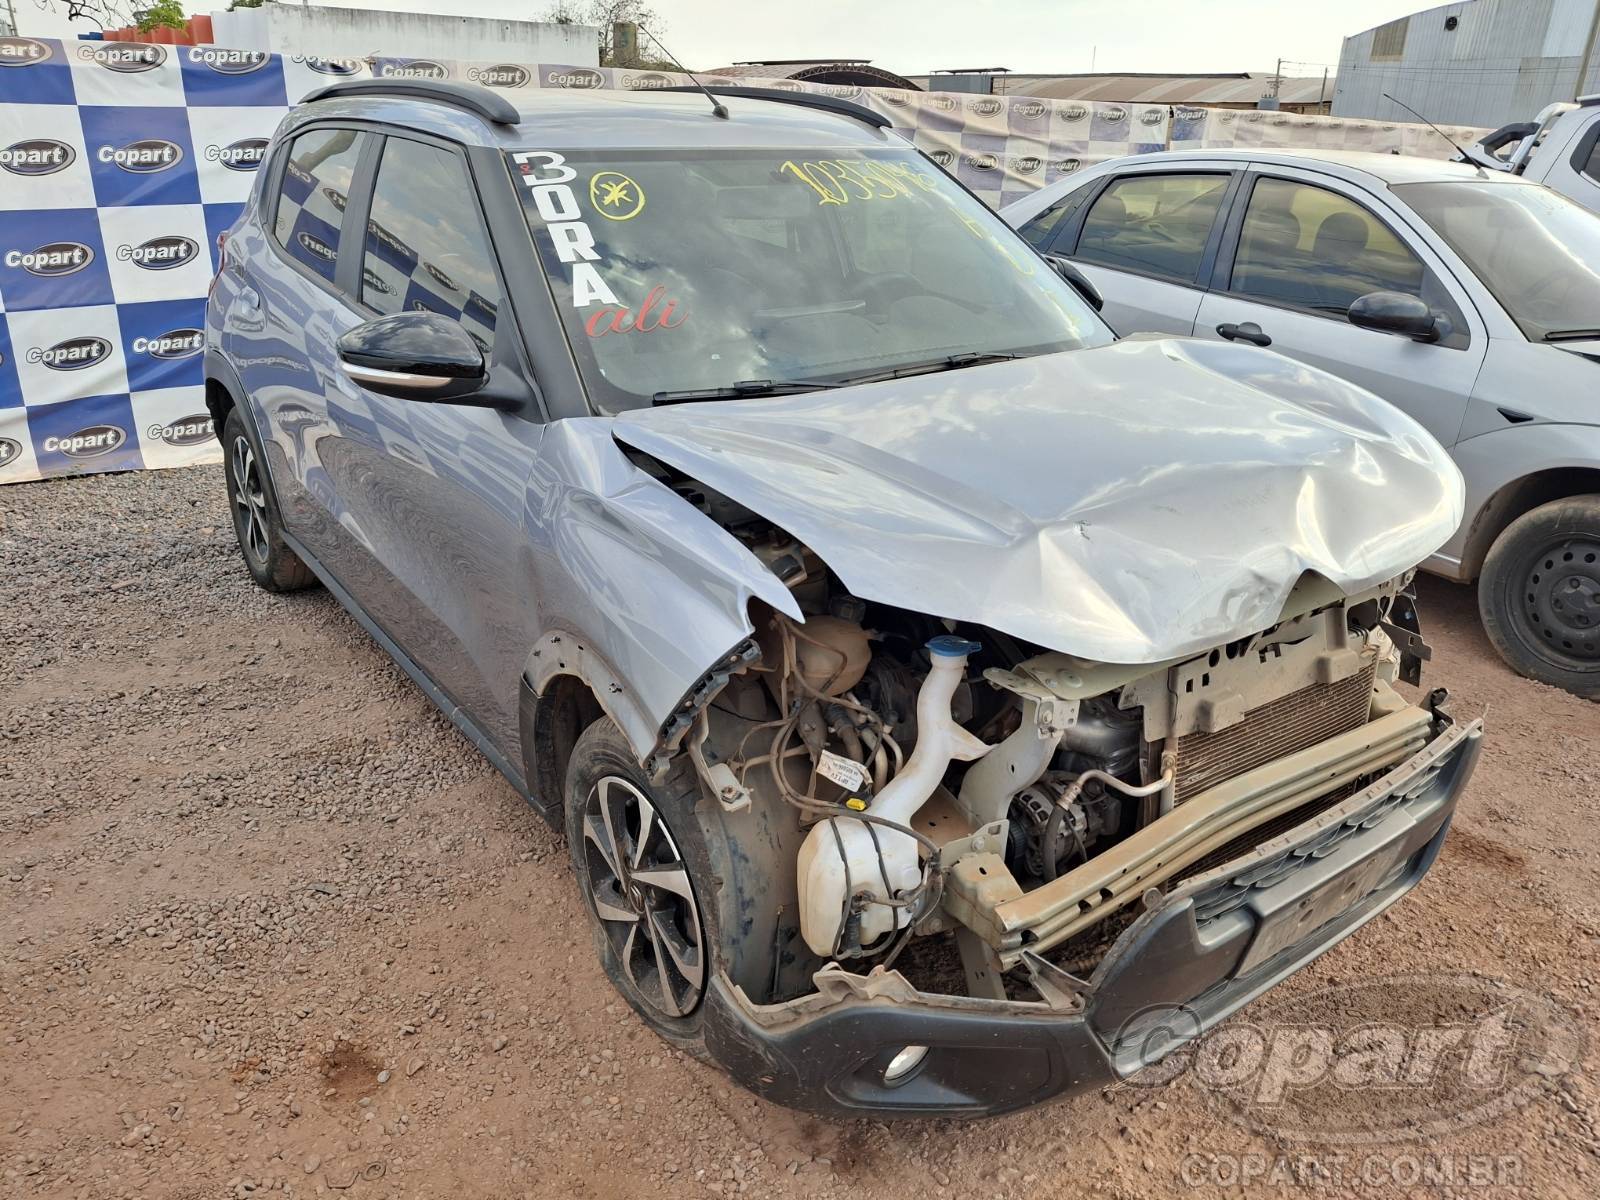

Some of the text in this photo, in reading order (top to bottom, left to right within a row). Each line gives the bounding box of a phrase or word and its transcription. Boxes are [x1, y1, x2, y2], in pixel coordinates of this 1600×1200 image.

[0, 41, 39, 57] art
[77, 45, 154, 64] Copart
[188, 47, 260, 65] Copart
[382, 65, 440, 79] Copart
[467, 68, 522, 85] Copart
[548, 72, 599, 87] Copart
[967, 101, 999, 114] Copart
[1013, 103, 1043, 115] Copart
[0, 146, 64, 166] opart
[98, 146, 173, 166] Copart
[204, 145, 264, 164] Copar
[930, 154, 950, 165] art
[1009, 158, 1038, 171] Copart
[5, 249, 82, 270] Copart
[116, 241, 188, 263] Copart
[585, 283, 690, 338] ali
[133, 332, 202, 355] Copart
[26, 342, 100, 365] Copart
[147, 418, 214, 441] Copart
[44, 430, 116, 453] Copart
